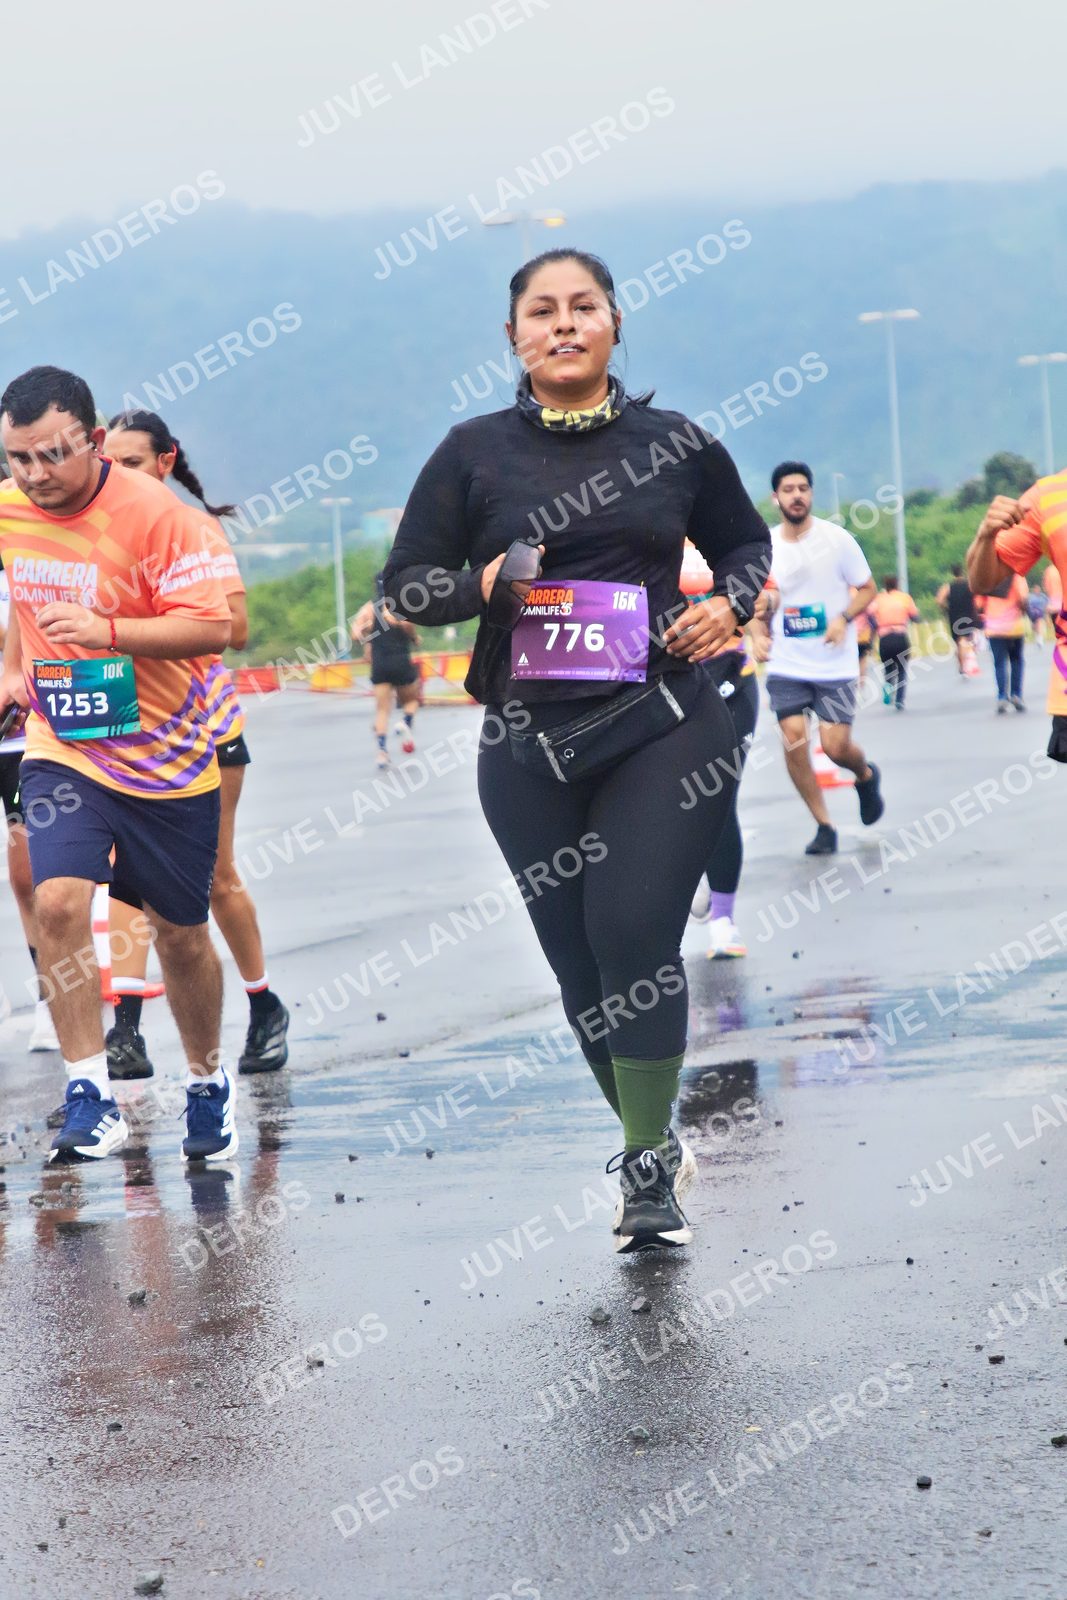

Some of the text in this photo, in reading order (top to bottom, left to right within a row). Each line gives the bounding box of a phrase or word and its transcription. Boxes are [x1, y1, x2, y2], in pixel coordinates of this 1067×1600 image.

[13, 557, 98, 588] CARRERA
[526, 588, 574, 606] ARRERA
[544, 623, 605, 652] 776
[37, 666, 72, 679] CARRERA
[103, 662, 124, 680] 10K
[47, 692, 109, 717] 1253
